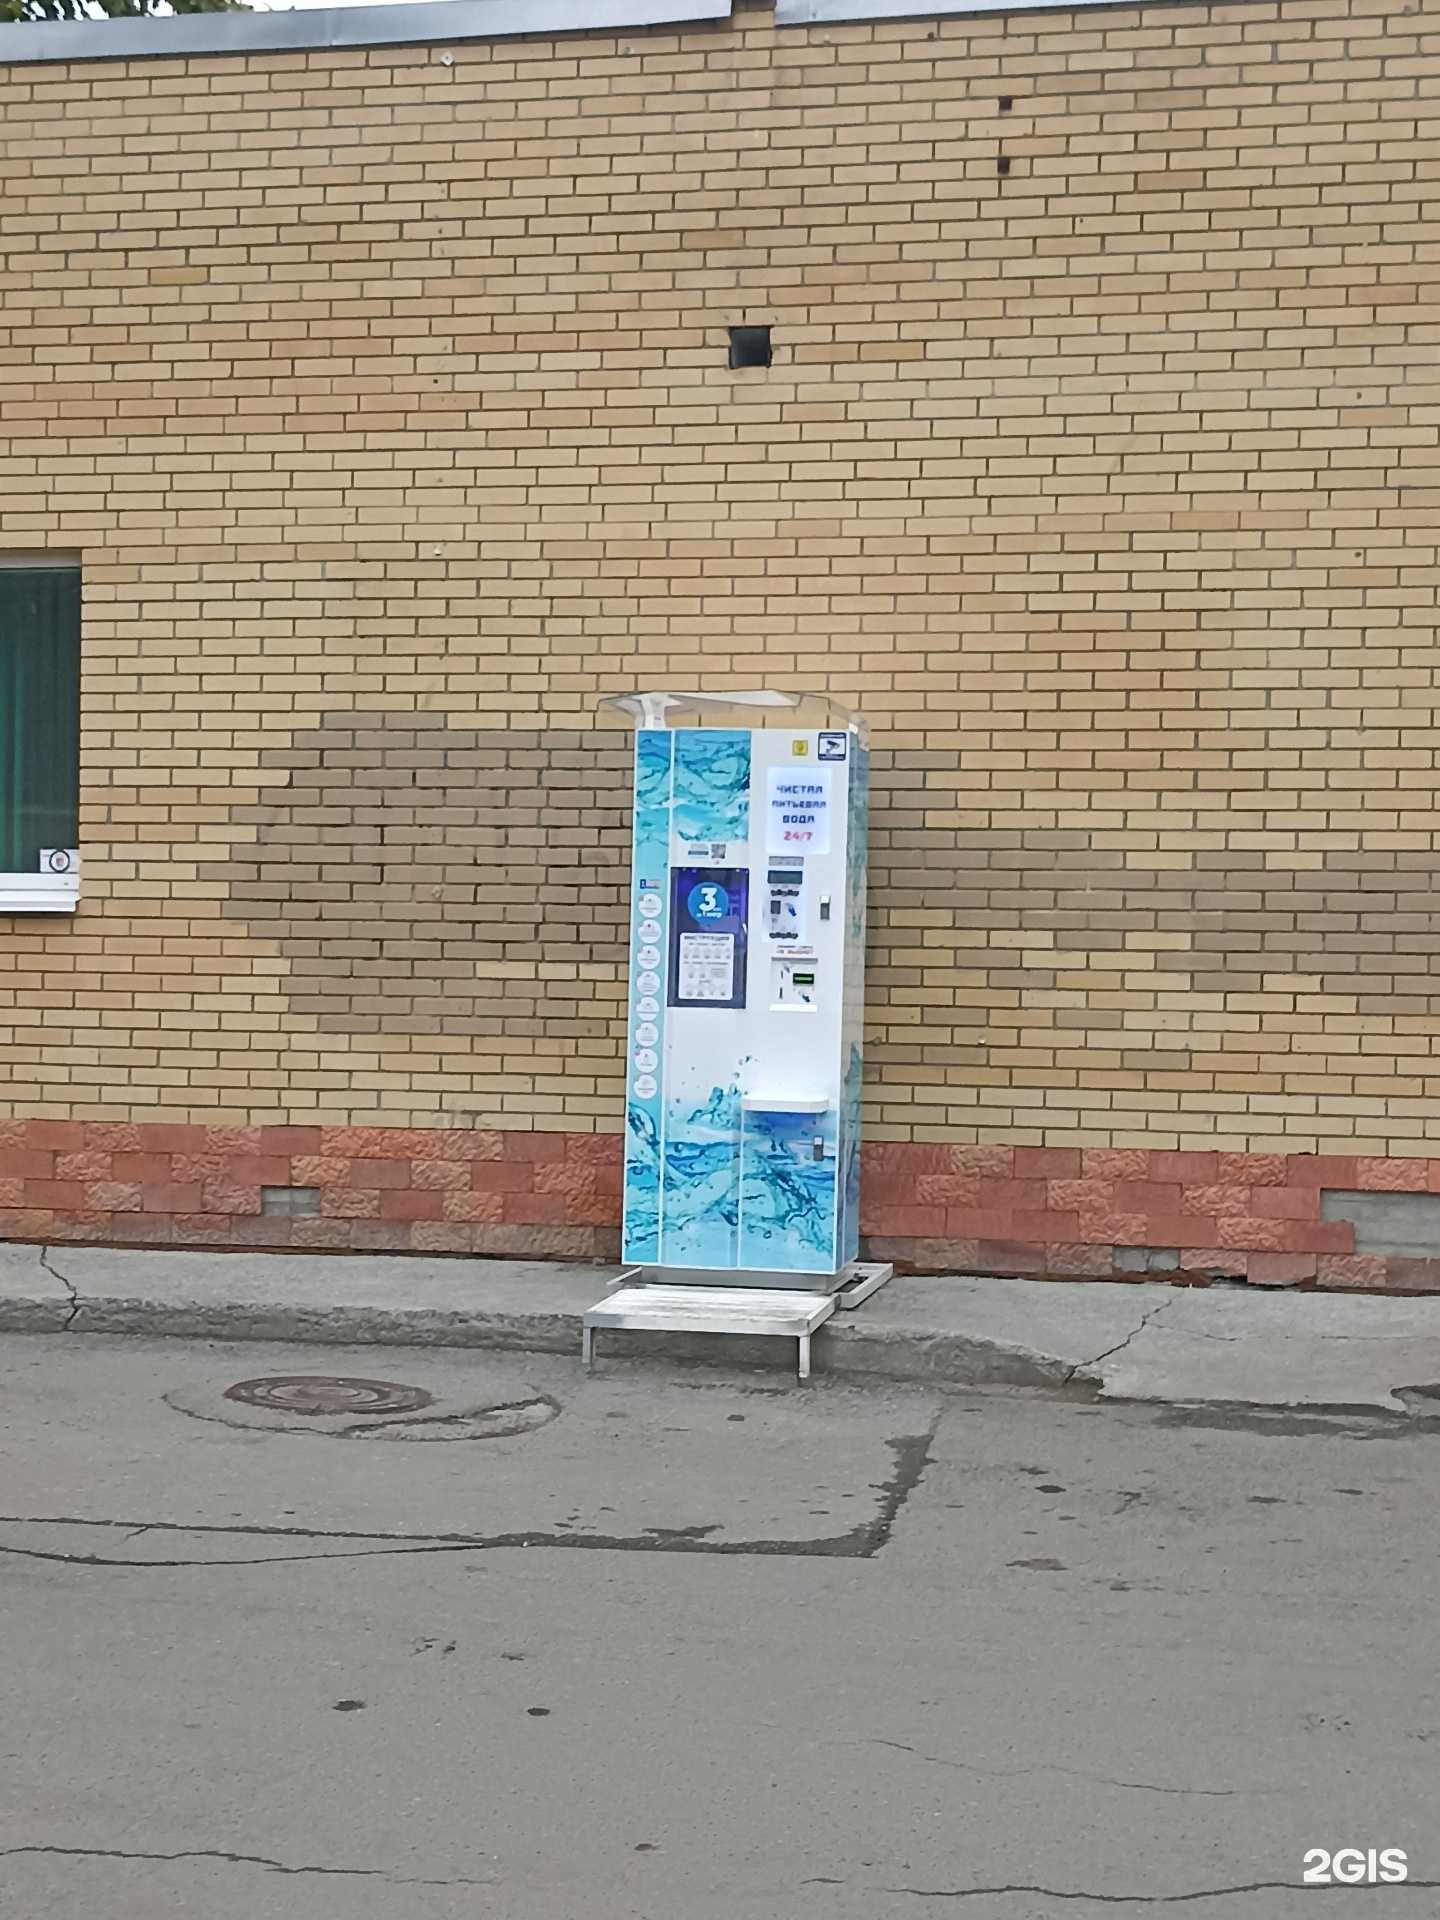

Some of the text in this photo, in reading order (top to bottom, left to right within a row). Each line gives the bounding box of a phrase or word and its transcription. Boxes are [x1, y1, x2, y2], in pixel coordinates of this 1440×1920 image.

[782, 815, 815, 824] ВОДА
[783, 831, 813, 841] 24/7
[699, 887, 718, 911] 3
